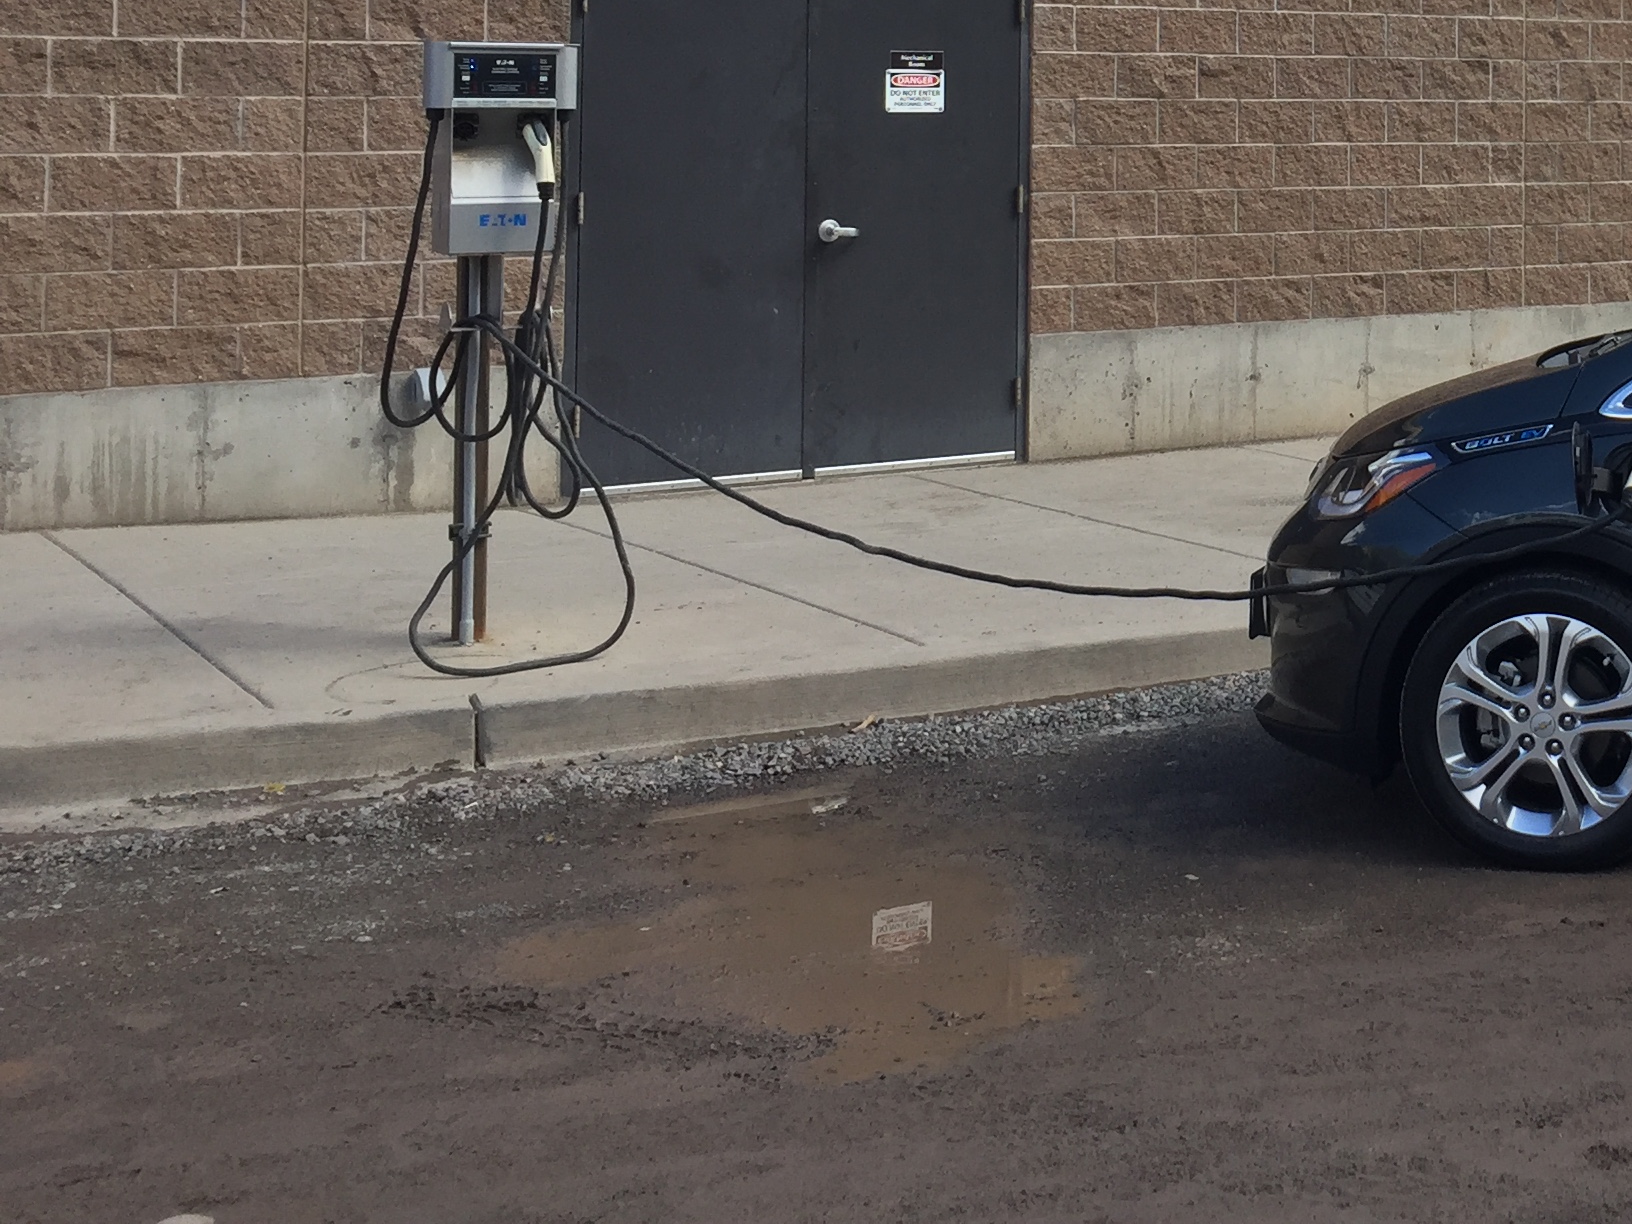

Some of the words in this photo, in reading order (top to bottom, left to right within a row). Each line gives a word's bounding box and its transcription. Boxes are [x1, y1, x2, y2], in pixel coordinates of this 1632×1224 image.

[897, 76, 934, 85] DANGER
[890, 89, 902, 97] DO
[903, 89, 917, 97] NOT
[918, 89, 941, 97] ENTER
[1464, 432, 1516, 450] BOLT
[1520, 428, 1545, 440] EV
